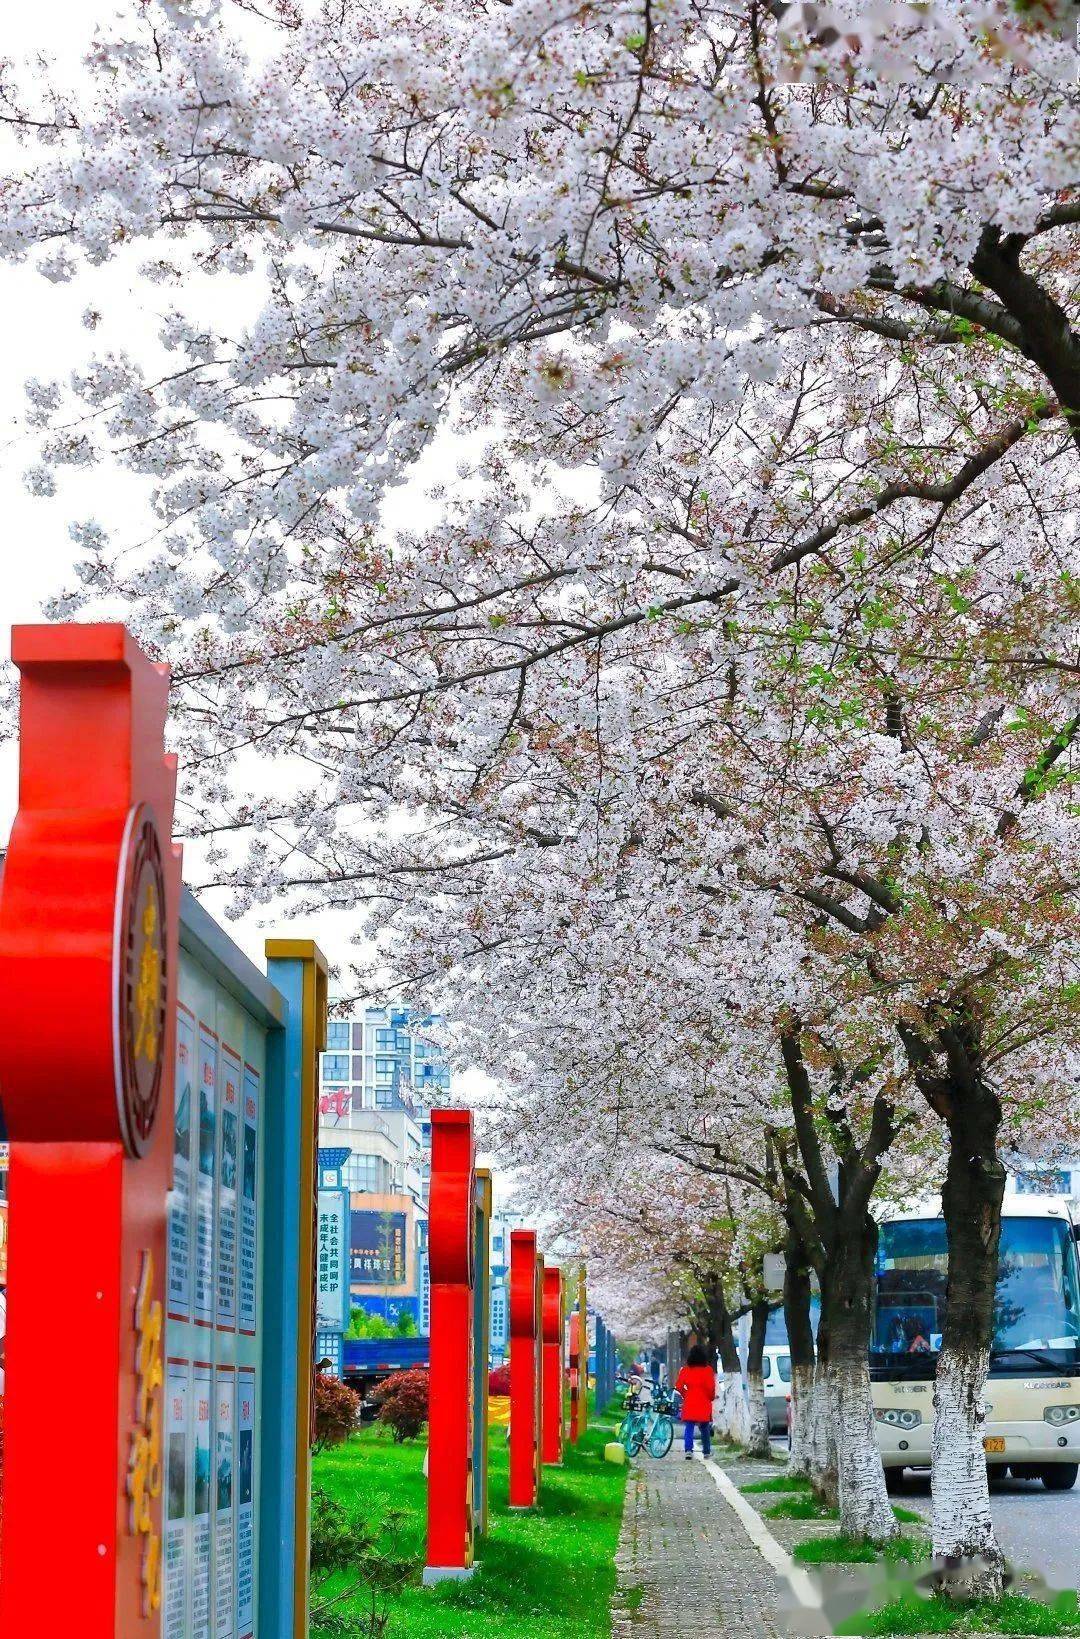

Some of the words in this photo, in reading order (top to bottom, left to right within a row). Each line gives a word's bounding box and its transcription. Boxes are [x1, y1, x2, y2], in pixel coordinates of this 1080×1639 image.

[319, 1213, 329, 1292] 未成年人健康成长
[329, 1213, 339, 1292] 全社会共同呵护
